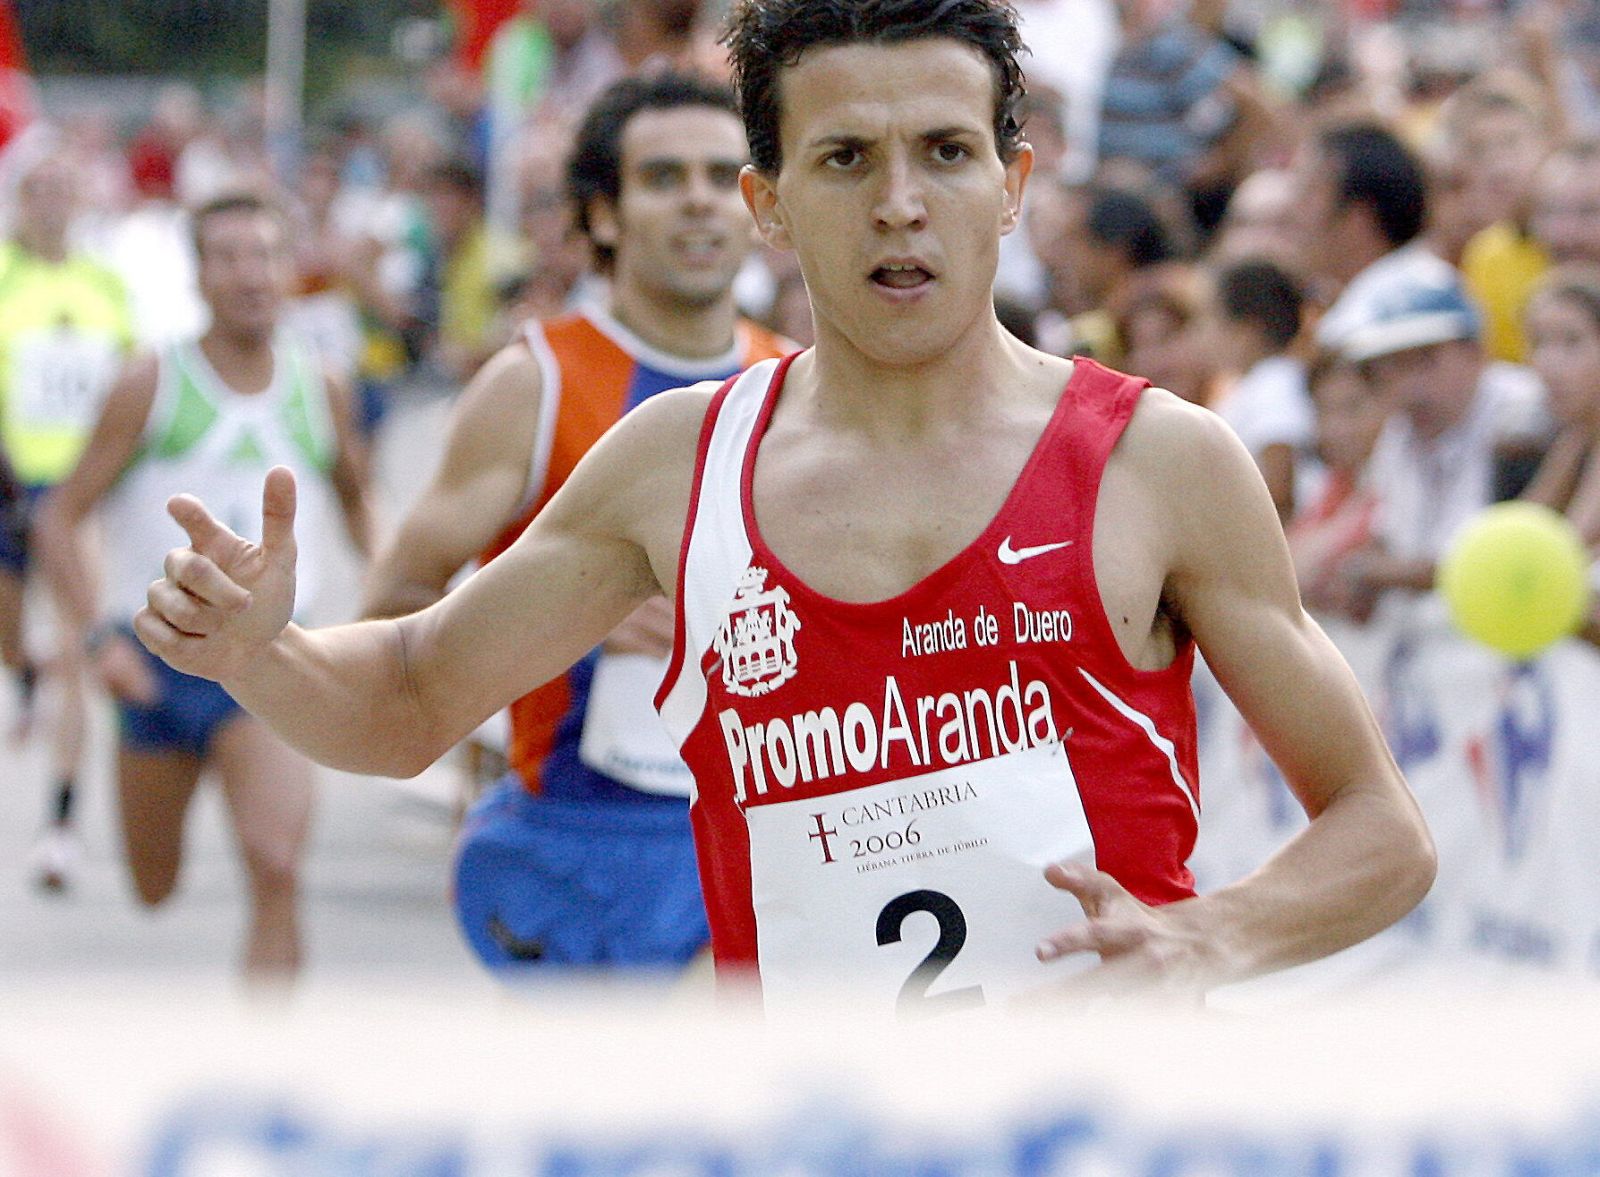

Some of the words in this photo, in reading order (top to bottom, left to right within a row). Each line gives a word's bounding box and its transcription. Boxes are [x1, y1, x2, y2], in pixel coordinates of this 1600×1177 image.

[902, 608, 967, 658] Aranda
[974, 605, 999, 647] de
[1013, 601, 1072, 644] Duero
[718, 660, 1058, 802] PromoAranda
[842, 781, 978, 826] CANTABRIA
[850, 819, 921, 858] 2006
[876, 889, 986, 1016] 2
